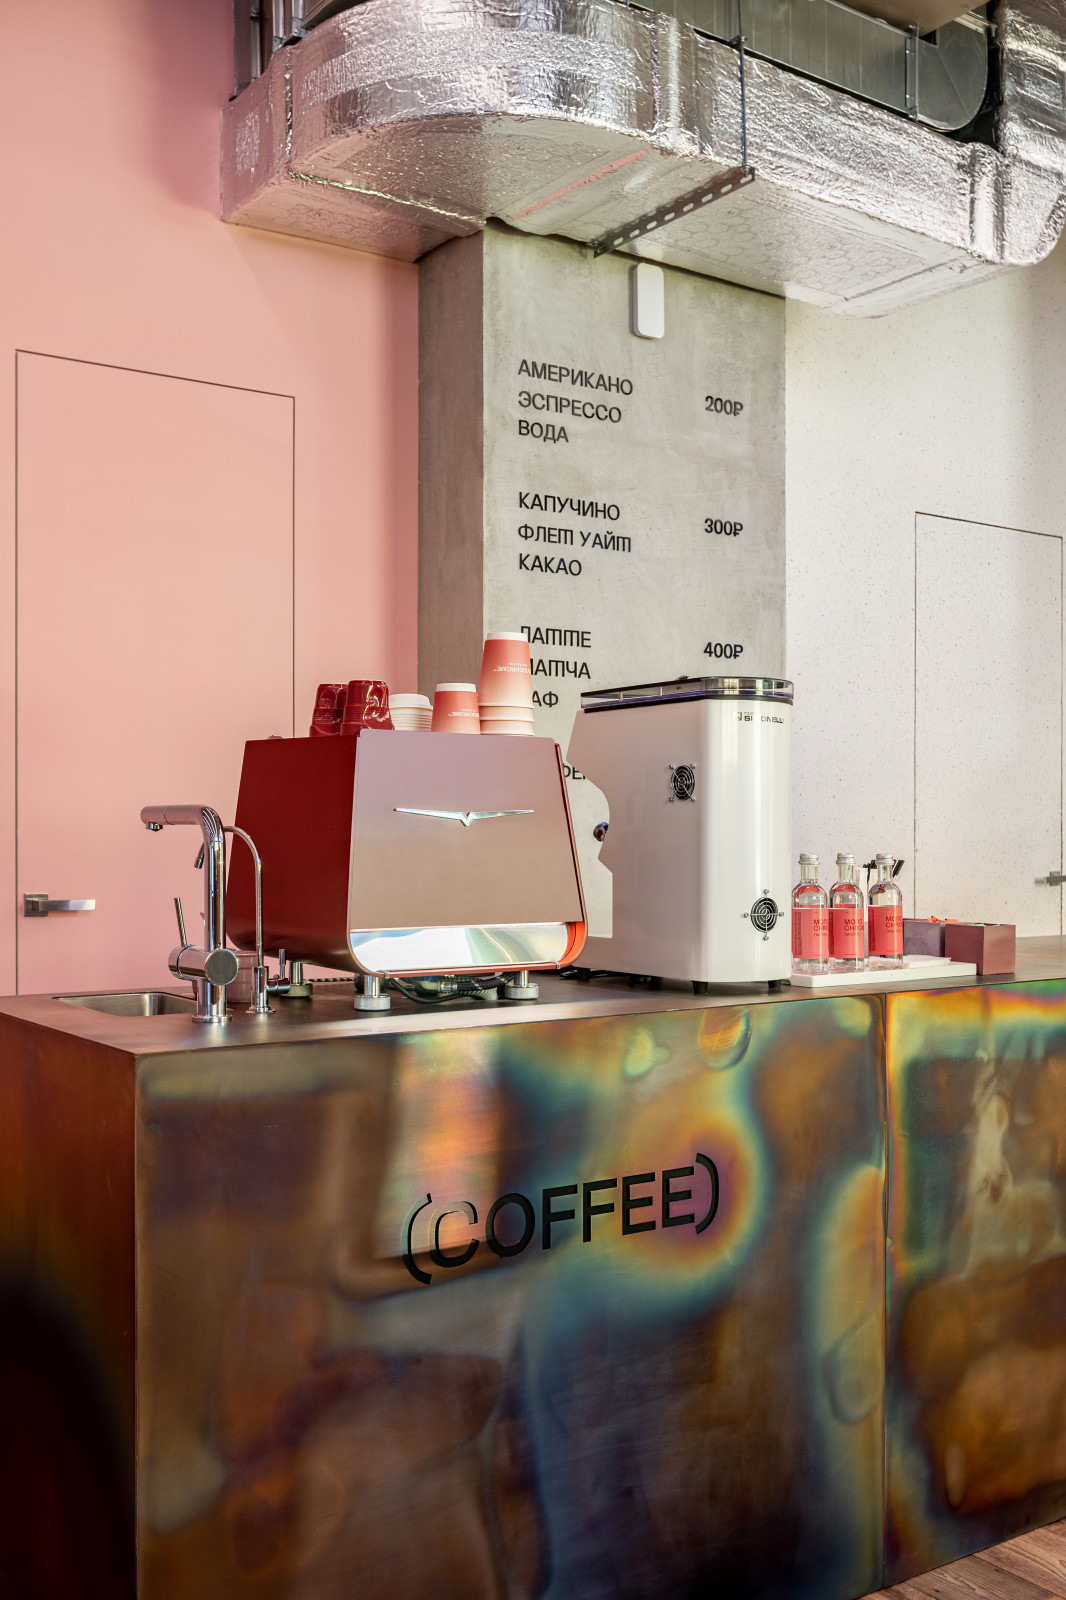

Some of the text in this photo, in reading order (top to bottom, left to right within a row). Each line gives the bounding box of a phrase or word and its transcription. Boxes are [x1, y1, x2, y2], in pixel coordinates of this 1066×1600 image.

[517, 359, 634, 396] АМЕРИКАНО
[518, 390, 622, 423] ЭСПРЕССО
[518, 419, 569, 444] ВОДА
[518, 491, 620, 521] КАПУЧИНО
[518, 552, 583, 577] КАКАО
[529, 658, 591, 679] АТЧА
[532, 690, 559, 708] АФ
[401, 1152, 720, 1285] (COFFEE)
